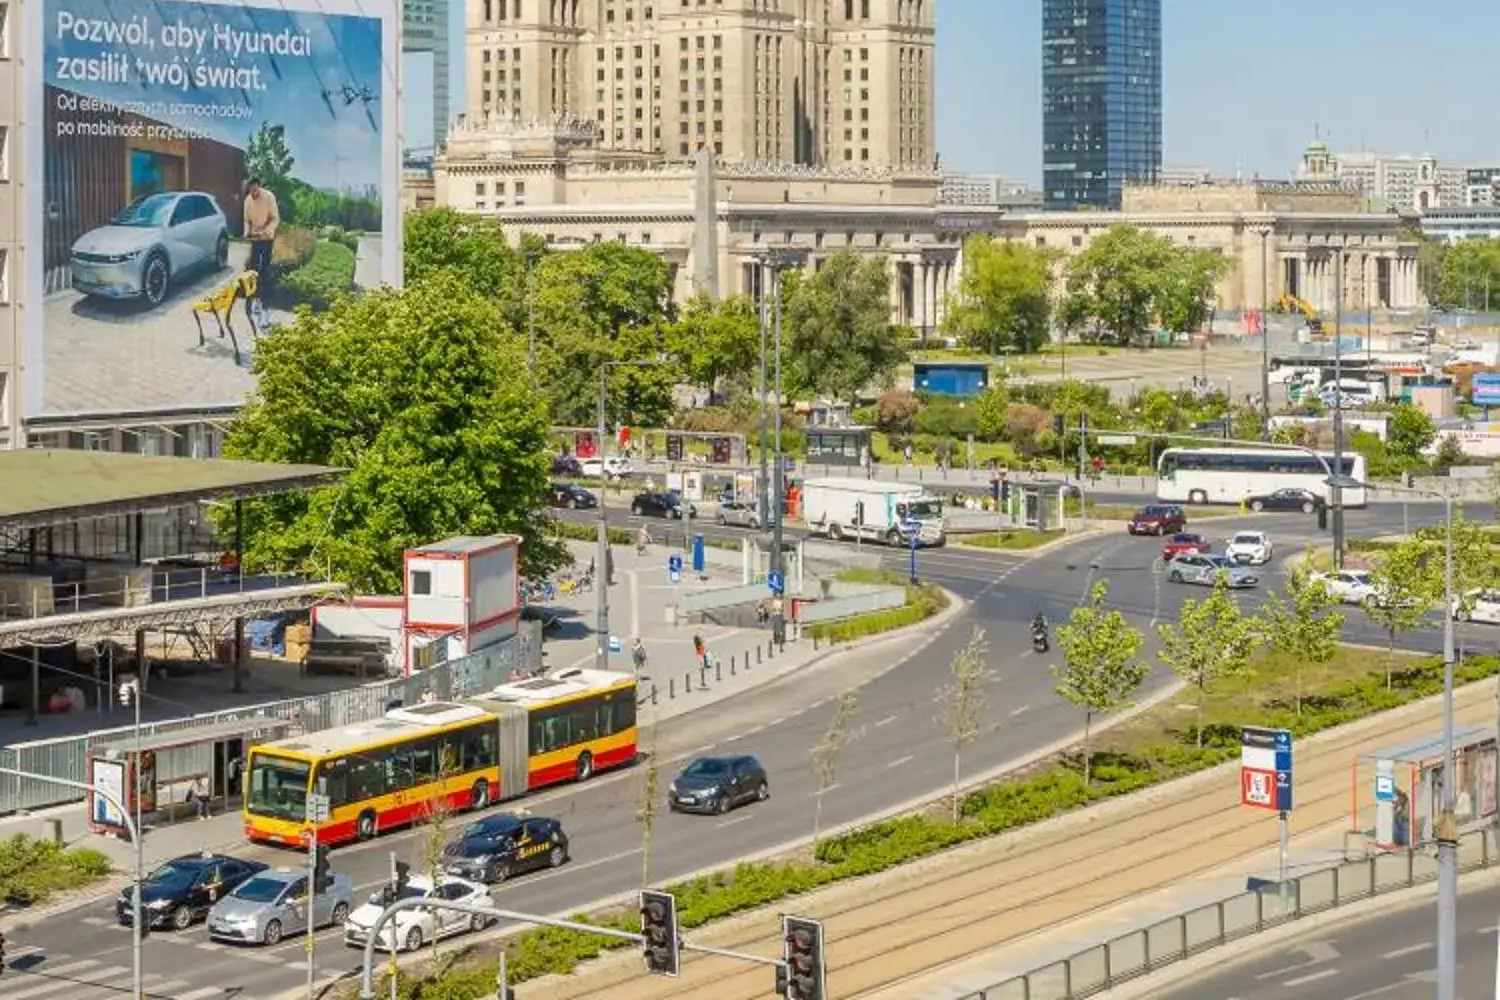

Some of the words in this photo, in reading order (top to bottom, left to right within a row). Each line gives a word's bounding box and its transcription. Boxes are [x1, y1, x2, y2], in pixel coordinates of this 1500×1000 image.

[57, 11, 155, 49] Pozwól,
[161, 20, 207, 56] aby
[213, 23, 311, 59] Hyundai
[56, 51, 129, 83] zasilił
[136, 57, 190, 90] twój
[57, 94, 77, 110] Od
[57, 121, 74, 136] po
[77, 119, 145, 137] mobilność
